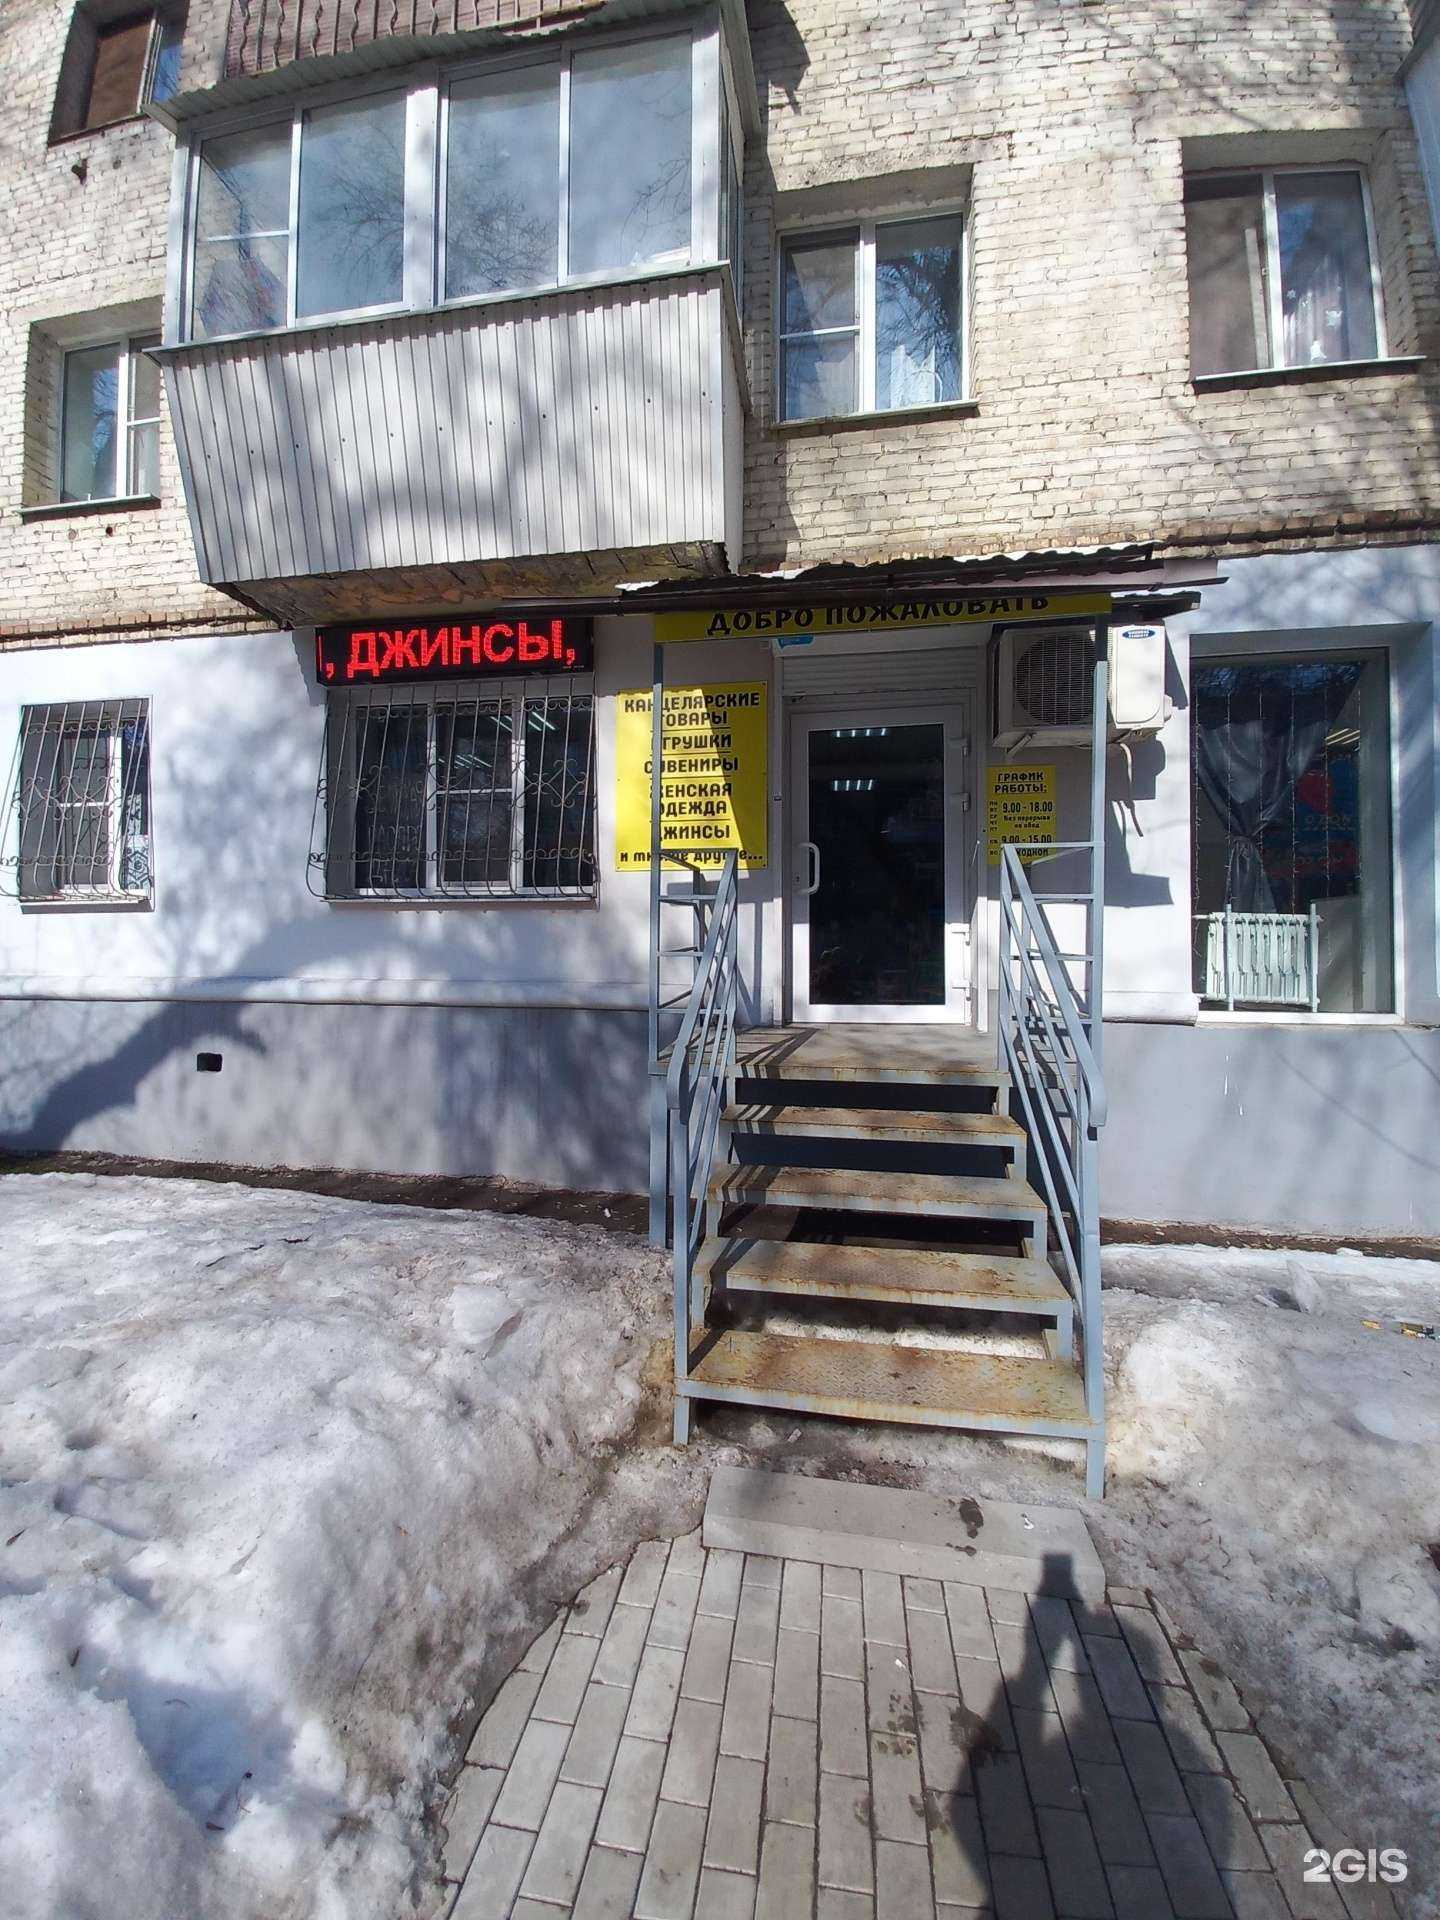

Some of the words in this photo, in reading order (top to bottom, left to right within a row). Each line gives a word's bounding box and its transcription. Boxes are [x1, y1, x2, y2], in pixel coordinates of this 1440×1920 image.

[707, 608, 813, 636] ДОБРО
[347, 620, 576, 678] ДЖИНСЫ,
[661, 711, 727, 728] ОВАРЫ
[651, 734, 732, 750] ГРУШКИ
[998, 772, 1044, 782] ГРАФИК
[1002, 802, 1021, 813] 9.00
[1029, 801, 1053, 813] 18.00
[659, 825, 730, 841] ЖИНСЫ
